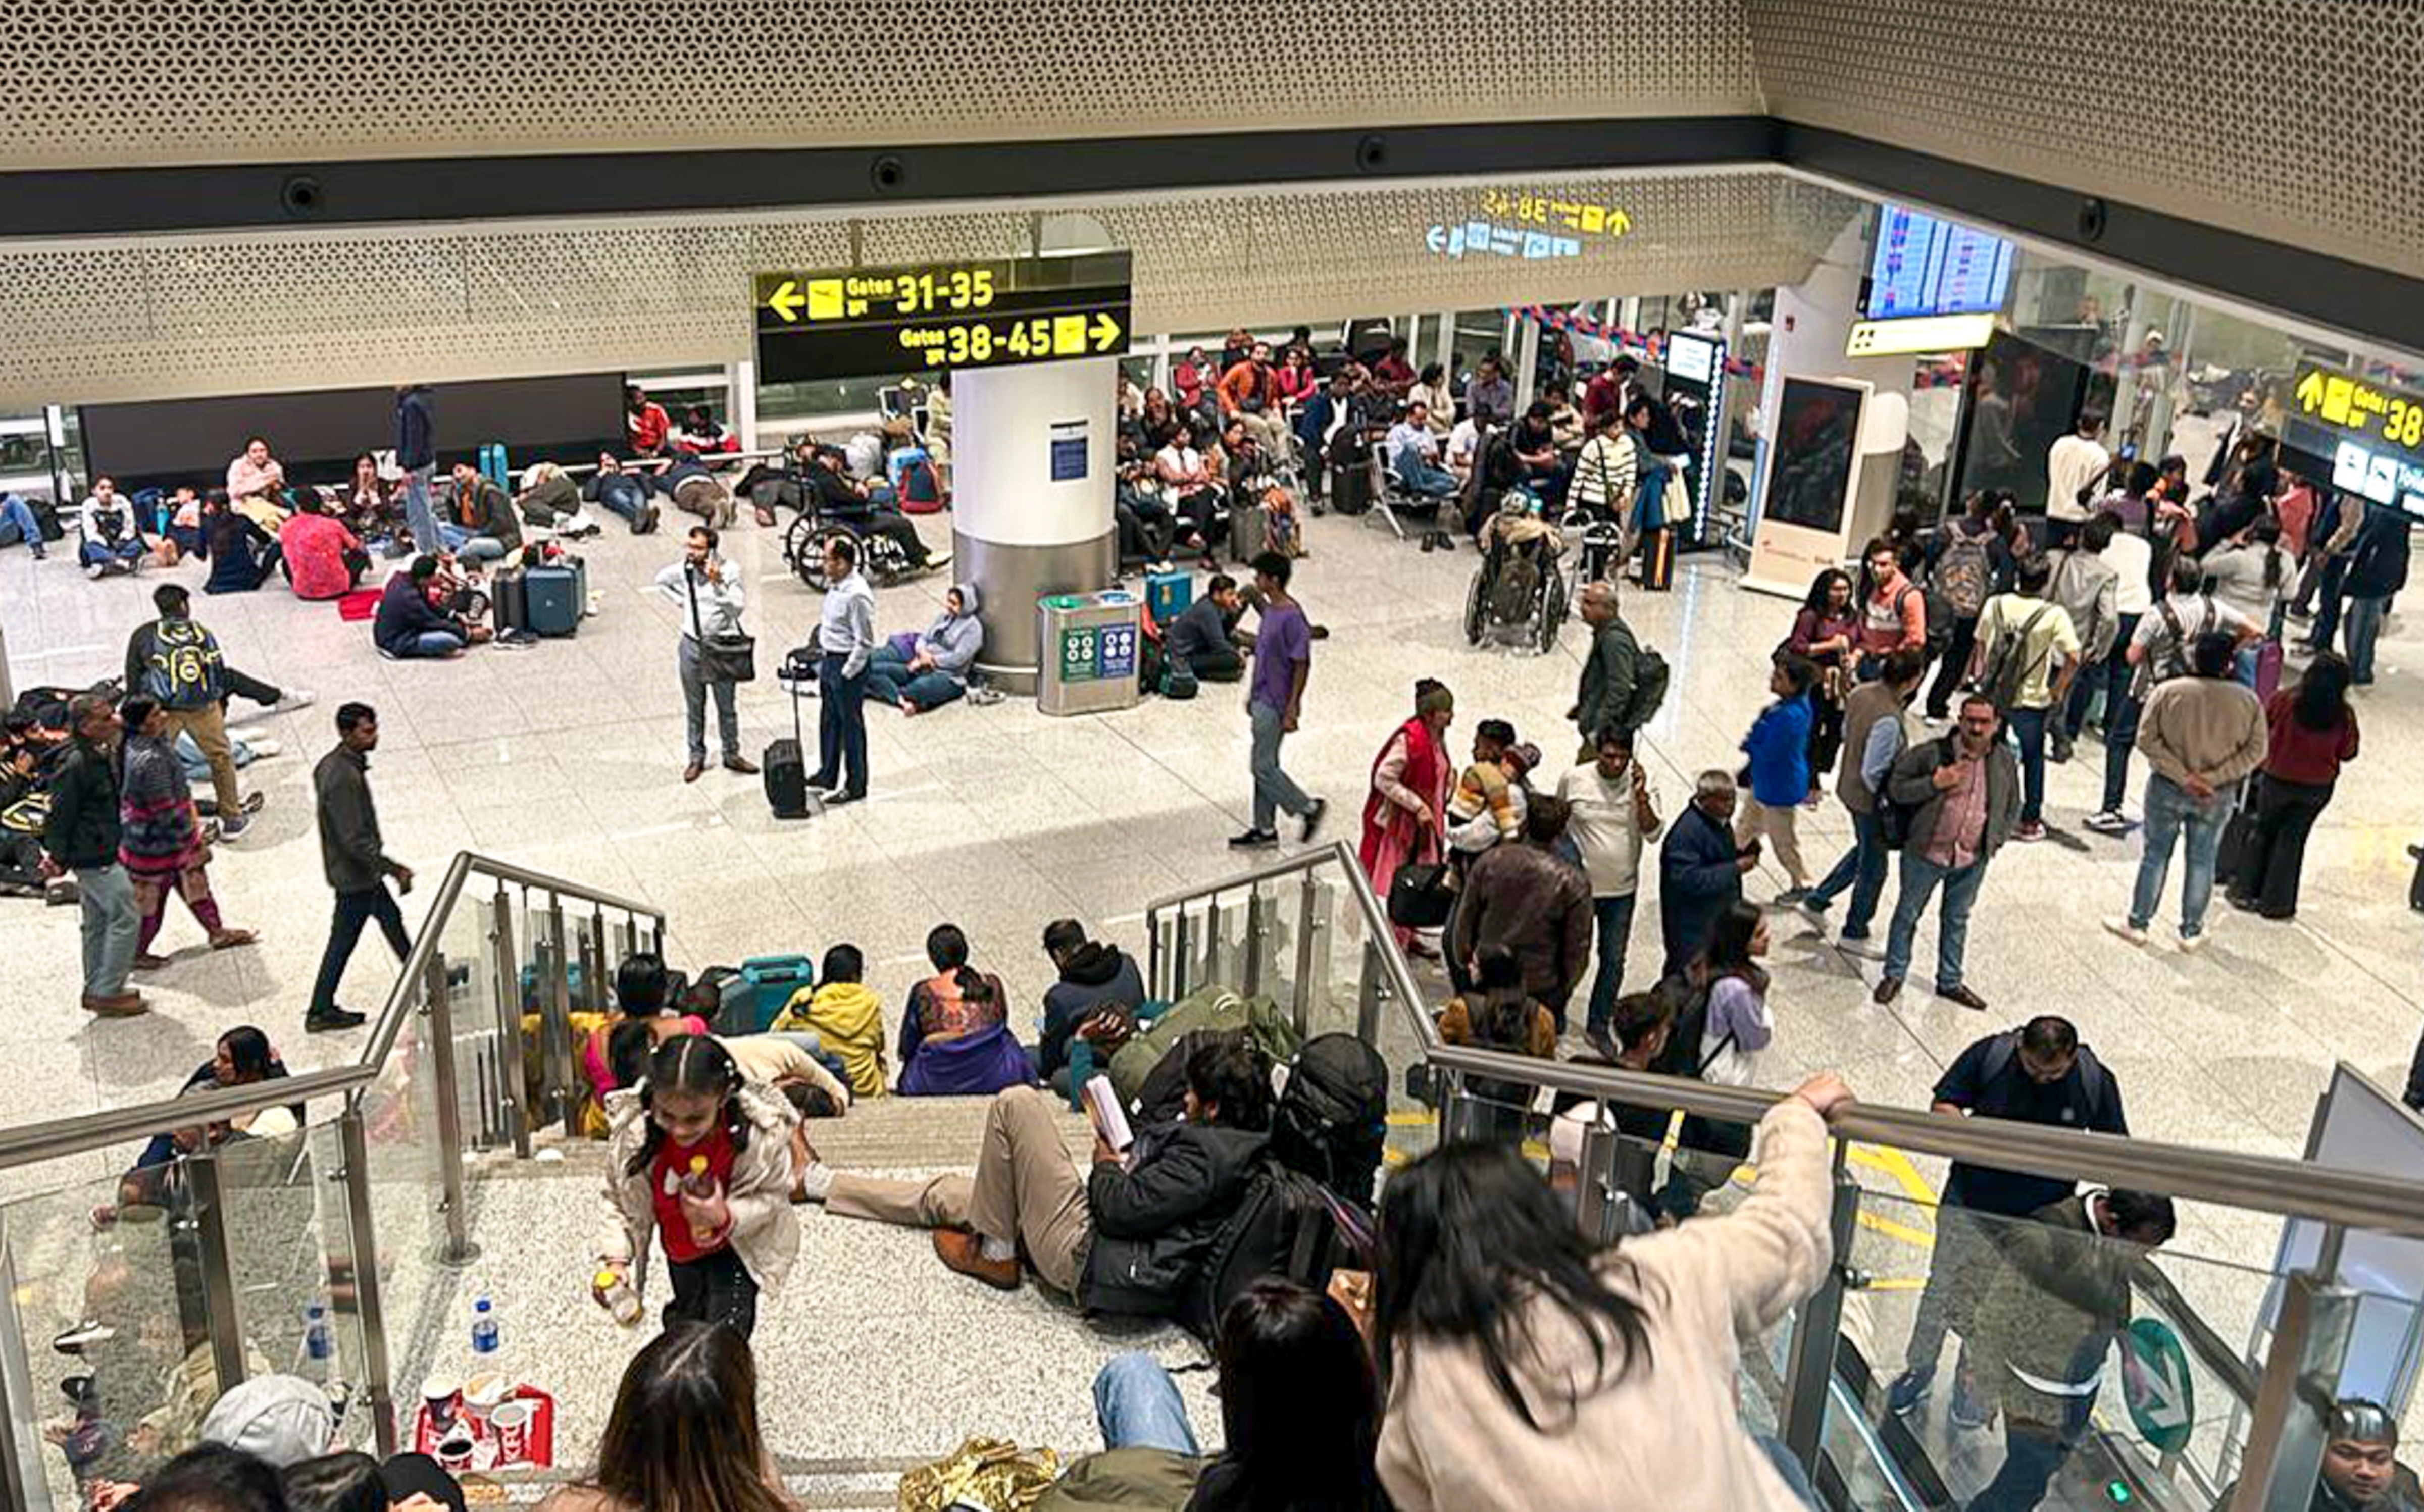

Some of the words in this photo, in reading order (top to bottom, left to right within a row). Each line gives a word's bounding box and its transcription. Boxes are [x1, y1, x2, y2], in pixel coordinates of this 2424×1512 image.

[847, 277, 893, 297] Gates
[896, 270, 994, 312] 31-35
[899, 328, 946, 348] Gates
[948, 321, 1050, 362] 38-45
[2383, 399, 2424, 447] 38
